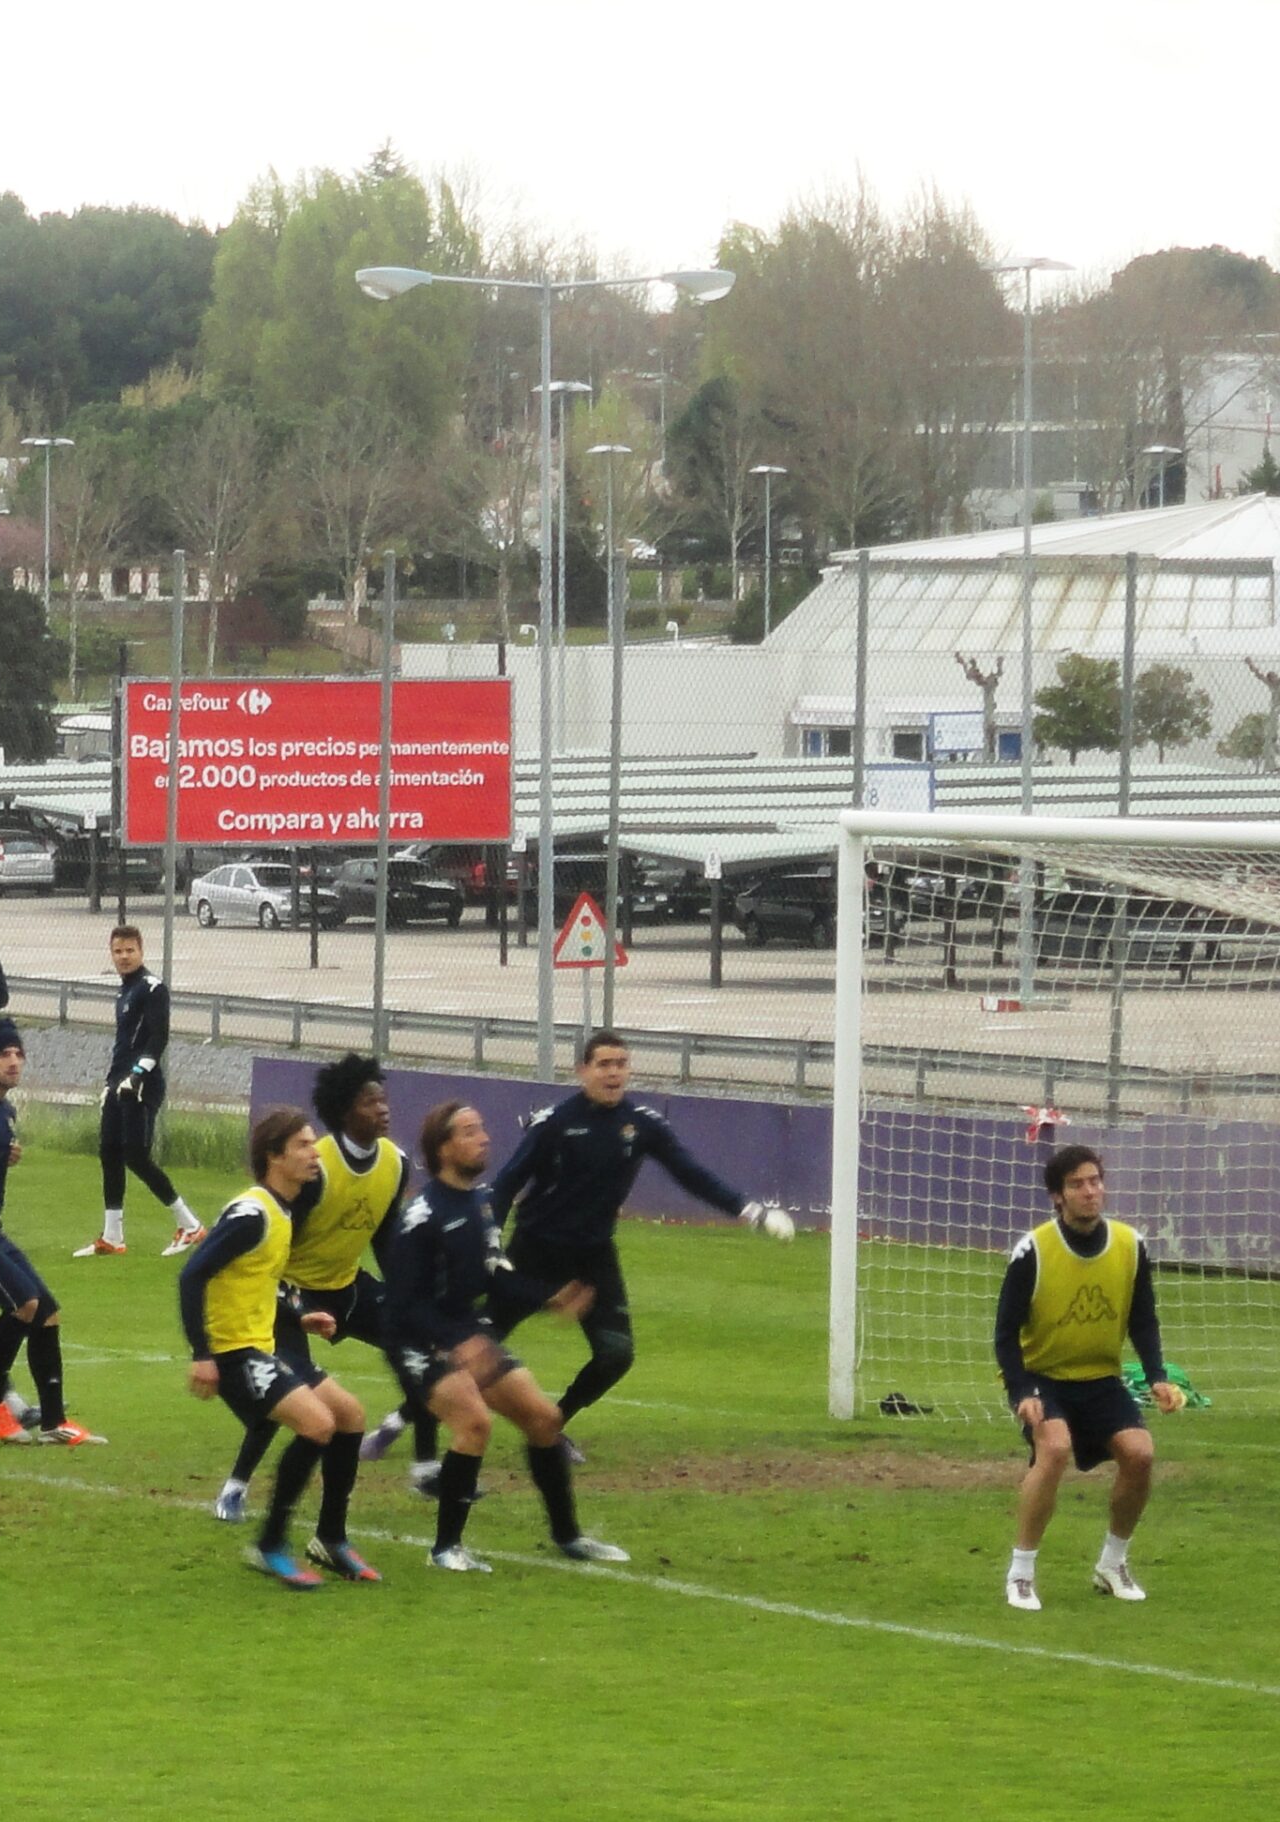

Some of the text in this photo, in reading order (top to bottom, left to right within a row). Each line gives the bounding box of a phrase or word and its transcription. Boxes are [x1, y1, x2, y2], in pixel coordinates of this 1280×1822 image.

[130, 733, 244, 764] Bajamos
[248, 737, 277, 757] los
[281, 737, 356, 761] precios
[179, 765, 256, 788] 2.000
[259, 771, 348, 790] productos
[350, 770, 371, 787] de
[374, 769, 484, 786] aimentación
[218, 809, 324, 834] Compara
[328, 812, 342, 834] y
